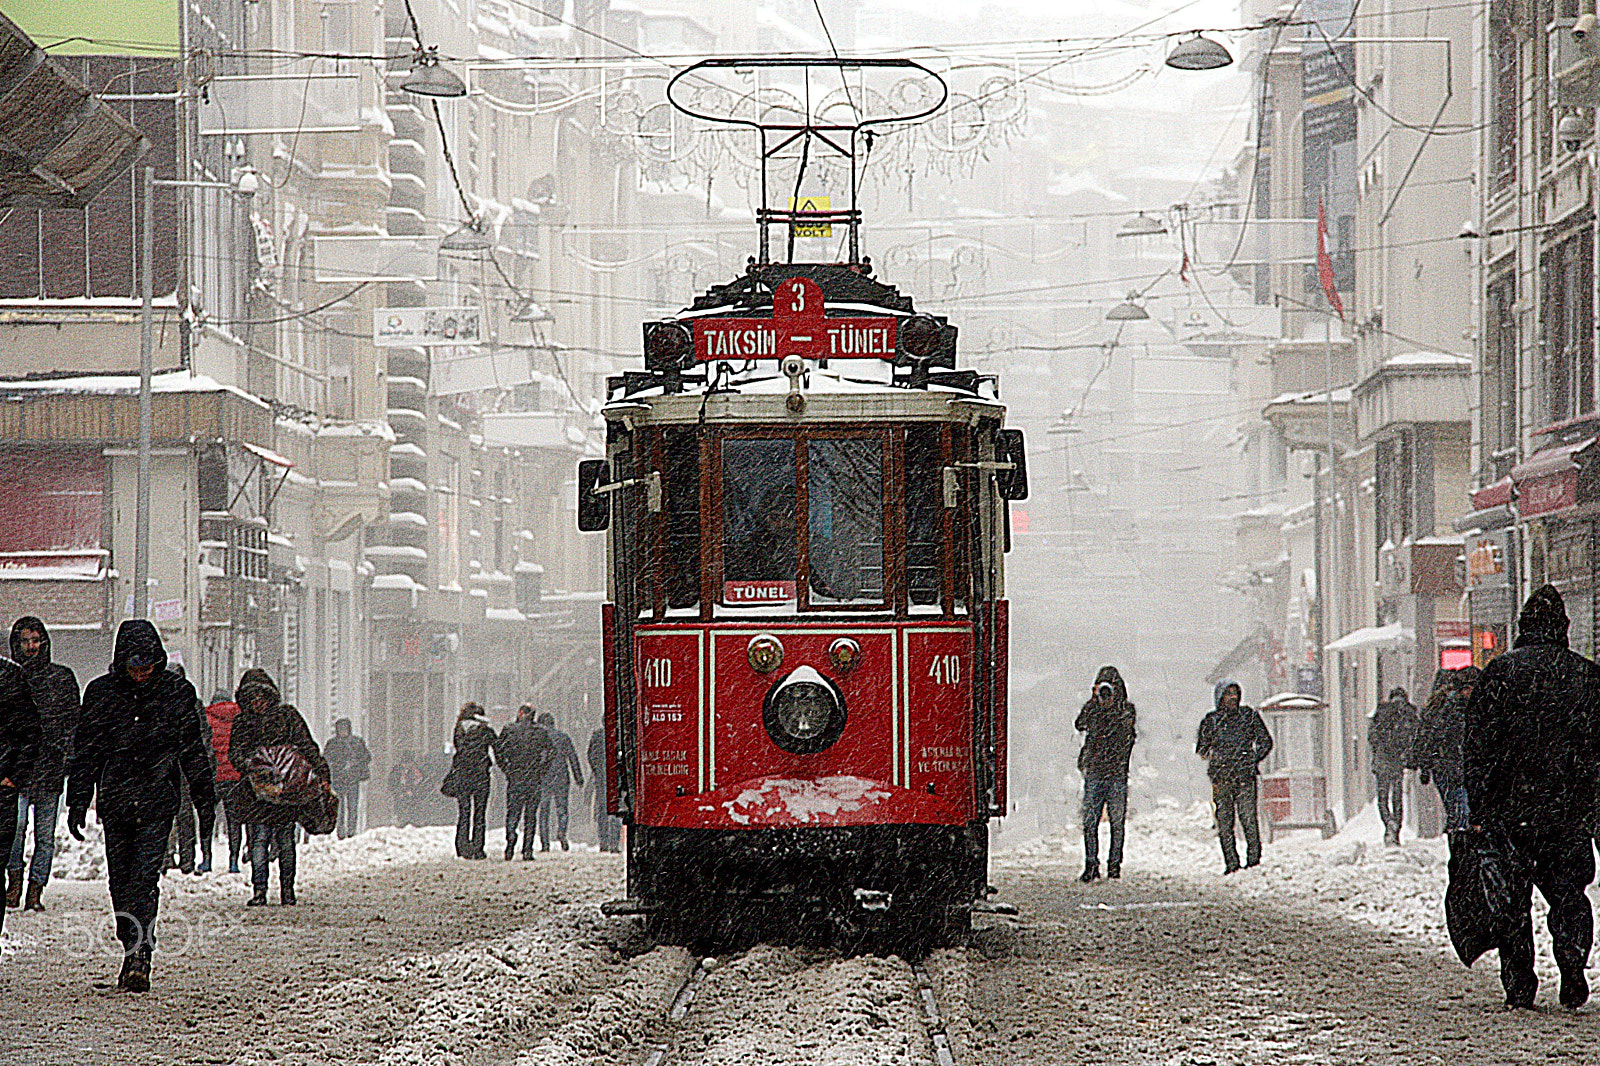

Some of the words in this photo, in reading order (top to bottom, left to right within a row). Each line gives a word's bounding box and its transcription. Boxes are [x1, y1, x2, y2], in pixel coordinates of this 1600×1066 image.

[795, 229, 826, 237] VOLT
[791, 283, 805, 312] 3
[703, 324, 776, 356] TAKSİM
[827, 324, 896, 355] TÜNEL
[733, 584, 789, 599] TÜNEL
[644, 658, 672, 688] 410
[928, 654, 960, 685] 410
